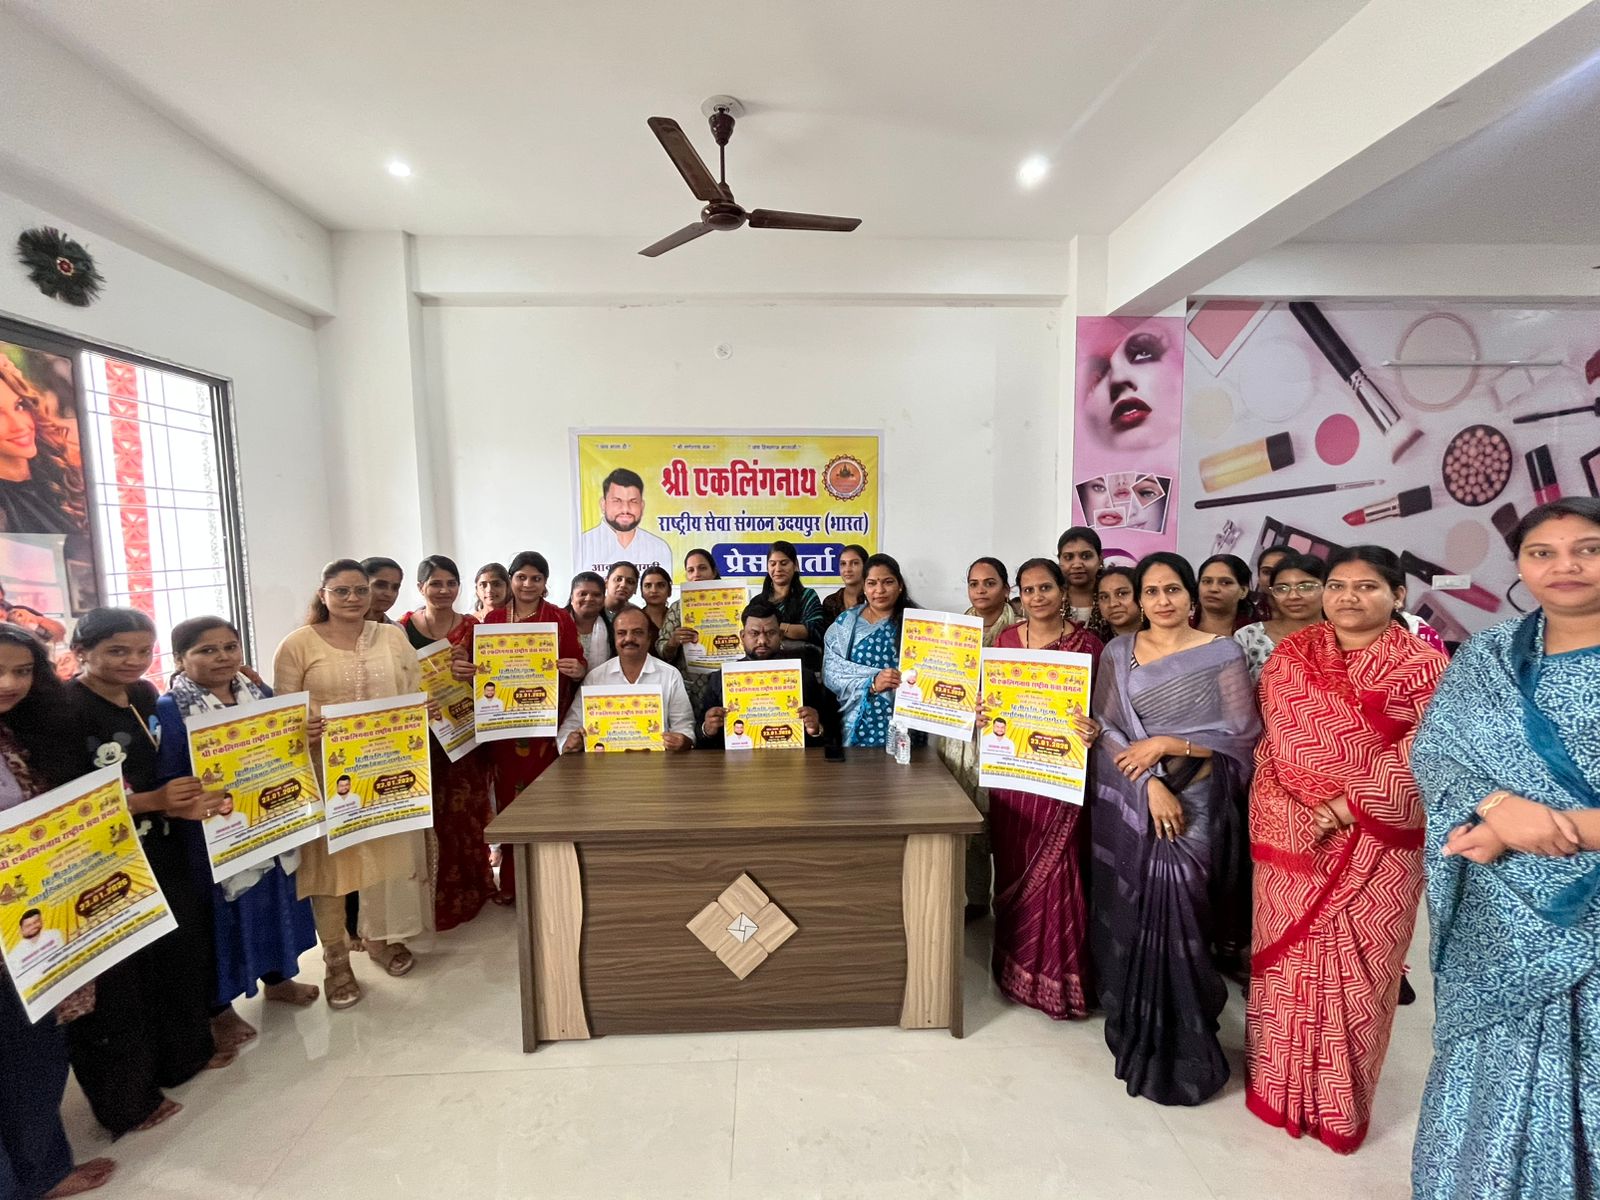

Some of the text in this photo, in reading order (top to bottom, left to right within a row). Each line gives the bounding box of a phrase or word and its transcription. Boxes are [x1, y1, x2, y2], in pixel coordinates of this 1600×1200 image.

[662, 459, 689, 497] श्री
[693, 459, 816, 497] एकलिंगनाथ
[658, 510, 870, 537] राष्ट्रीय सेवा संगठन उदयपुर (भारत)
[723, 547, 836, 573] प्रेस ार्ता
